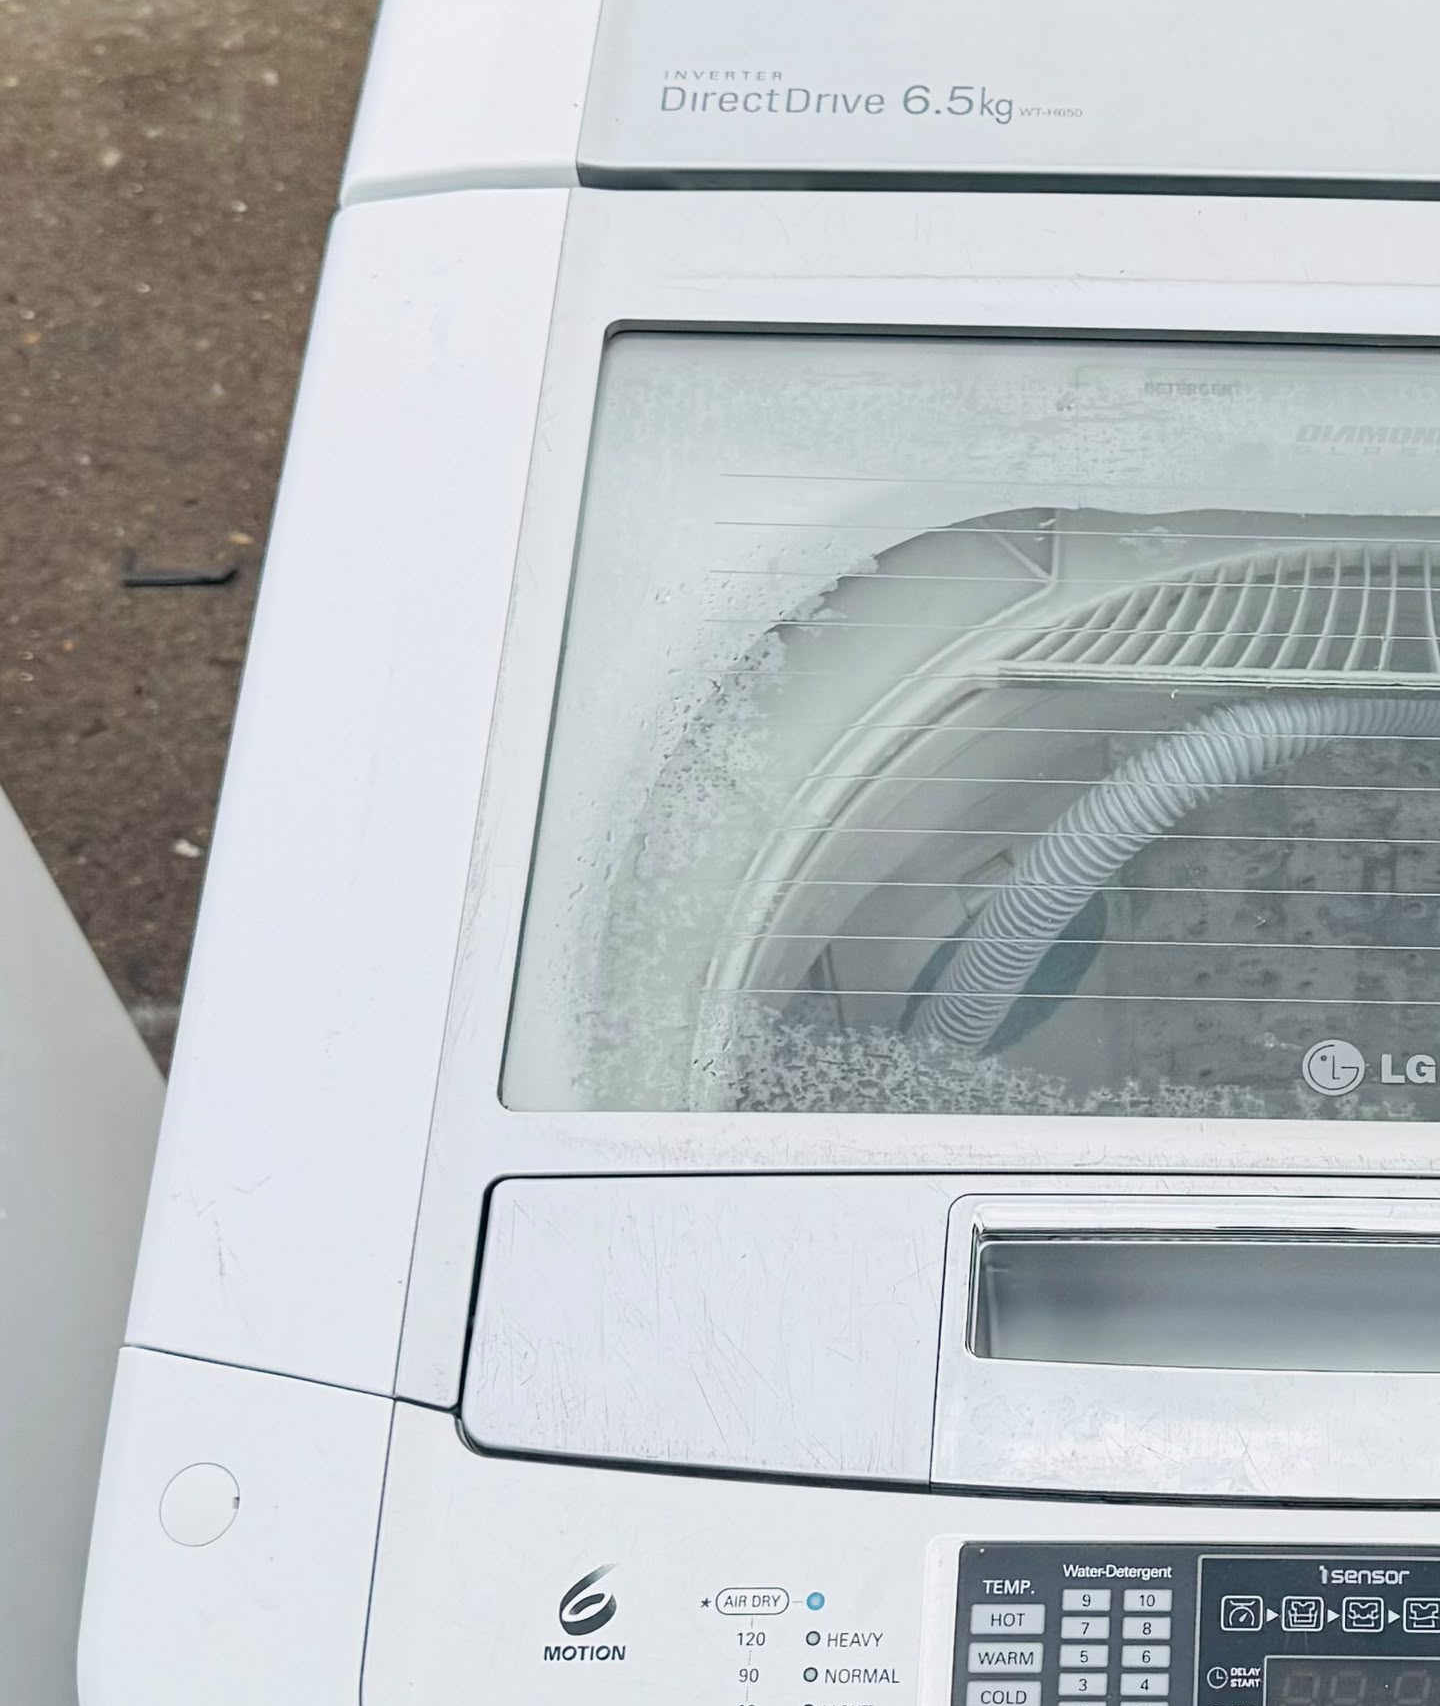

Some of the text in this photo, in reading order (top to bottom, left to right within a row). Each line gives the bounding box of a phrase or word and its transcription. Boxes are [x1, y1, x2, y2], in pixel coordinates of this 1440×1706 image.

[664, 69, 783, 82] INVERTER
[1381, 1053, 1437, 1084] LG
[1063, 1564, 1173, 1580] Water-Detergent
[983, 1580, 1035, 1595] TEMP.
[724, 1596, 781, 1608] AIR DRY
[1082, 1594, 1091, 1607] 9
[1140, 1594, 1156, 1607] 10
[990, 1613, 1025, 1627] HOT
[1081, 1622, 1090, 1635] 7
[1143, 1622, 1152, 1635] 8
[737, 1632, 766, 1646] 120
[826, 1632, 883, 1647] HEAVY
[543, 1646, 627, 1661] MOTION
[978, 1651, 1035, 1665] WARM
[1080, 1650, 1089, 1663] 5
[1142, 1651, 1151, 1663] 6
[738, 1668, 759, 1683] 90
[824, 1668, 900, 1684] NORMAL
[1230, 1667, 1261, 1677] DELAY
[1078, 1679, 1088, 1692] 3
[1140, 1679, 1149, 1691] 4
[1230, 1678, 1262, 1688] START
[980, 1690, 1027, 1705] COLD
